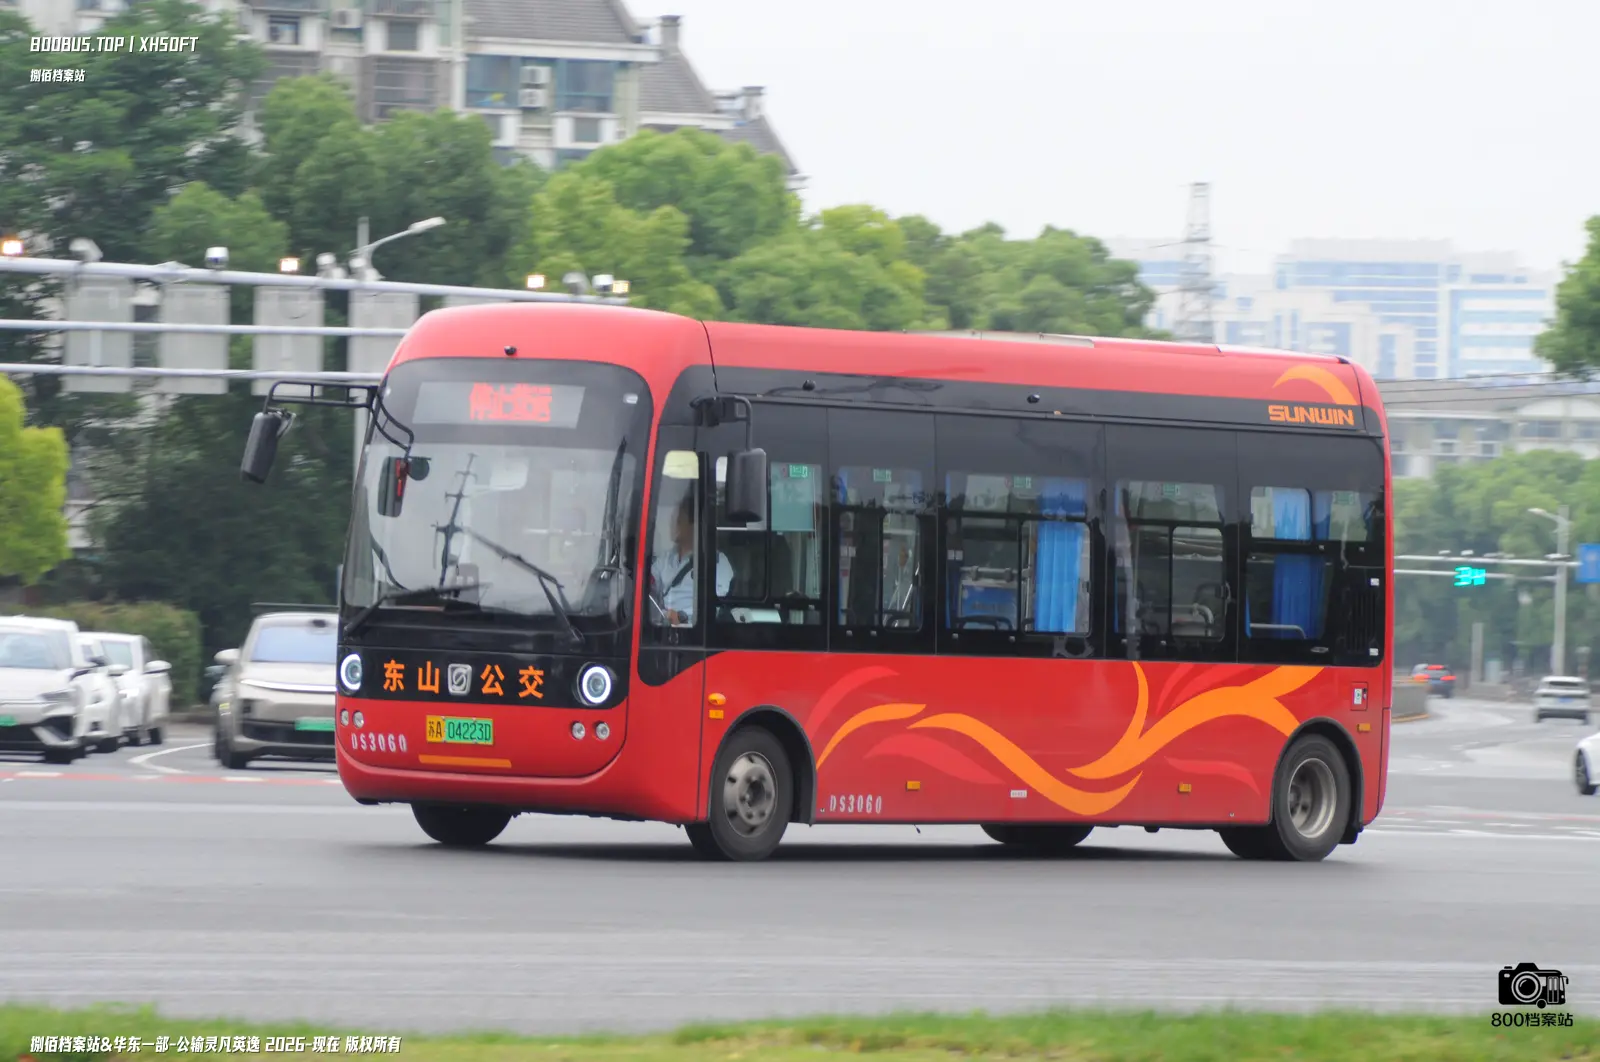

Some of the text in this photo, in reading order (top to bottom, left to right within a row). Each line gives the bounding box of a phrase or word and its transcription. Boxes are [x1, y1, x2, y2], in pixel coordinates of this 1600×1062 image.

[1268, 405, 1354, 426] SUNWIN
[383, 660, 545, 699] 东山 公交
[448, 721, 492, 741] 04223D
[351, 732, 408, 752] DS3060
[830, 794, 882, 814] DS3060
